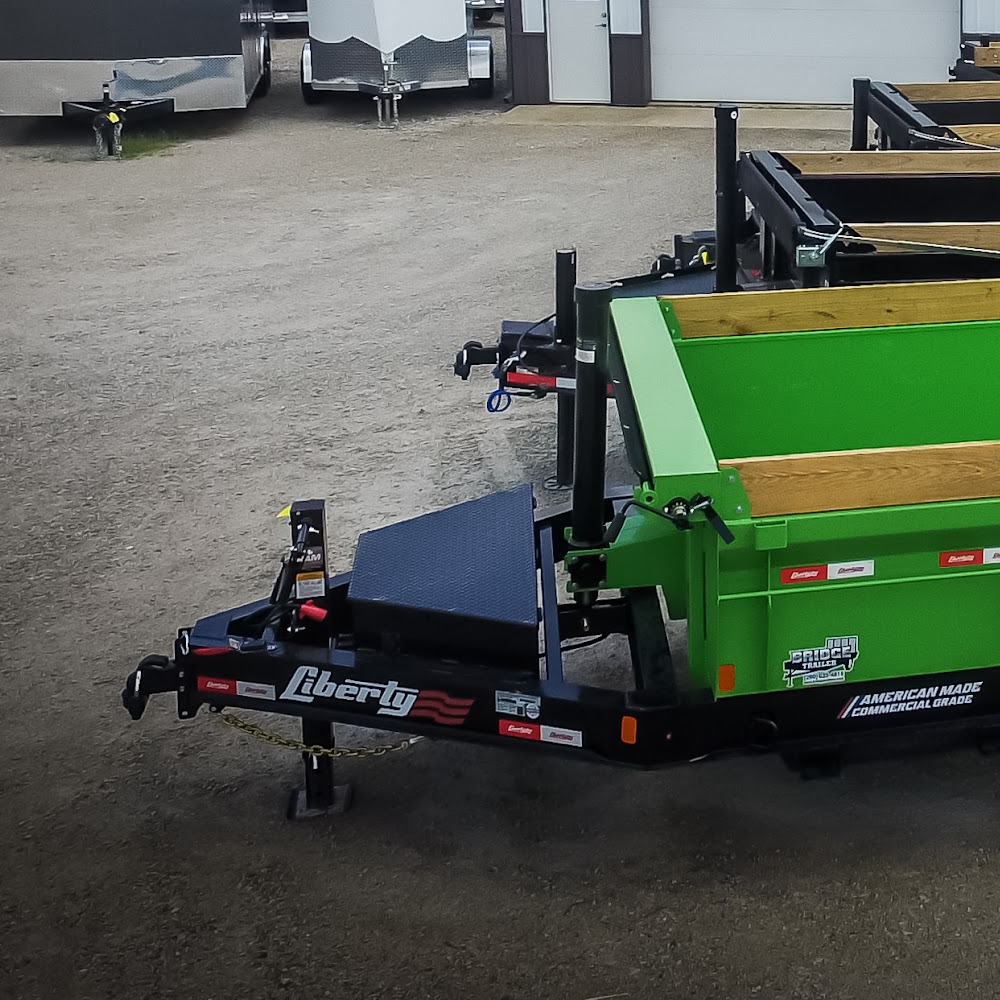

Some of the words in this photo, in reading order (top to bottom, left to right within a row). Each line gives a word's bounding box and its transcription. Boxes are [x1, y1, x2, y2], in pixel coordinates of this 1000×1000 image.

[792, 646, 852, 664] BRIDGE
[802, 660, 837, 669] TRAILER
[279, 665, 419, 717] Liberty
[859, 686, 939, 705] AMERICAN
[939, 681, 984, 696] MADE
[851, 702, 931, 717] COMMERCIAL
[932, 695, 974, 708] GRADE
